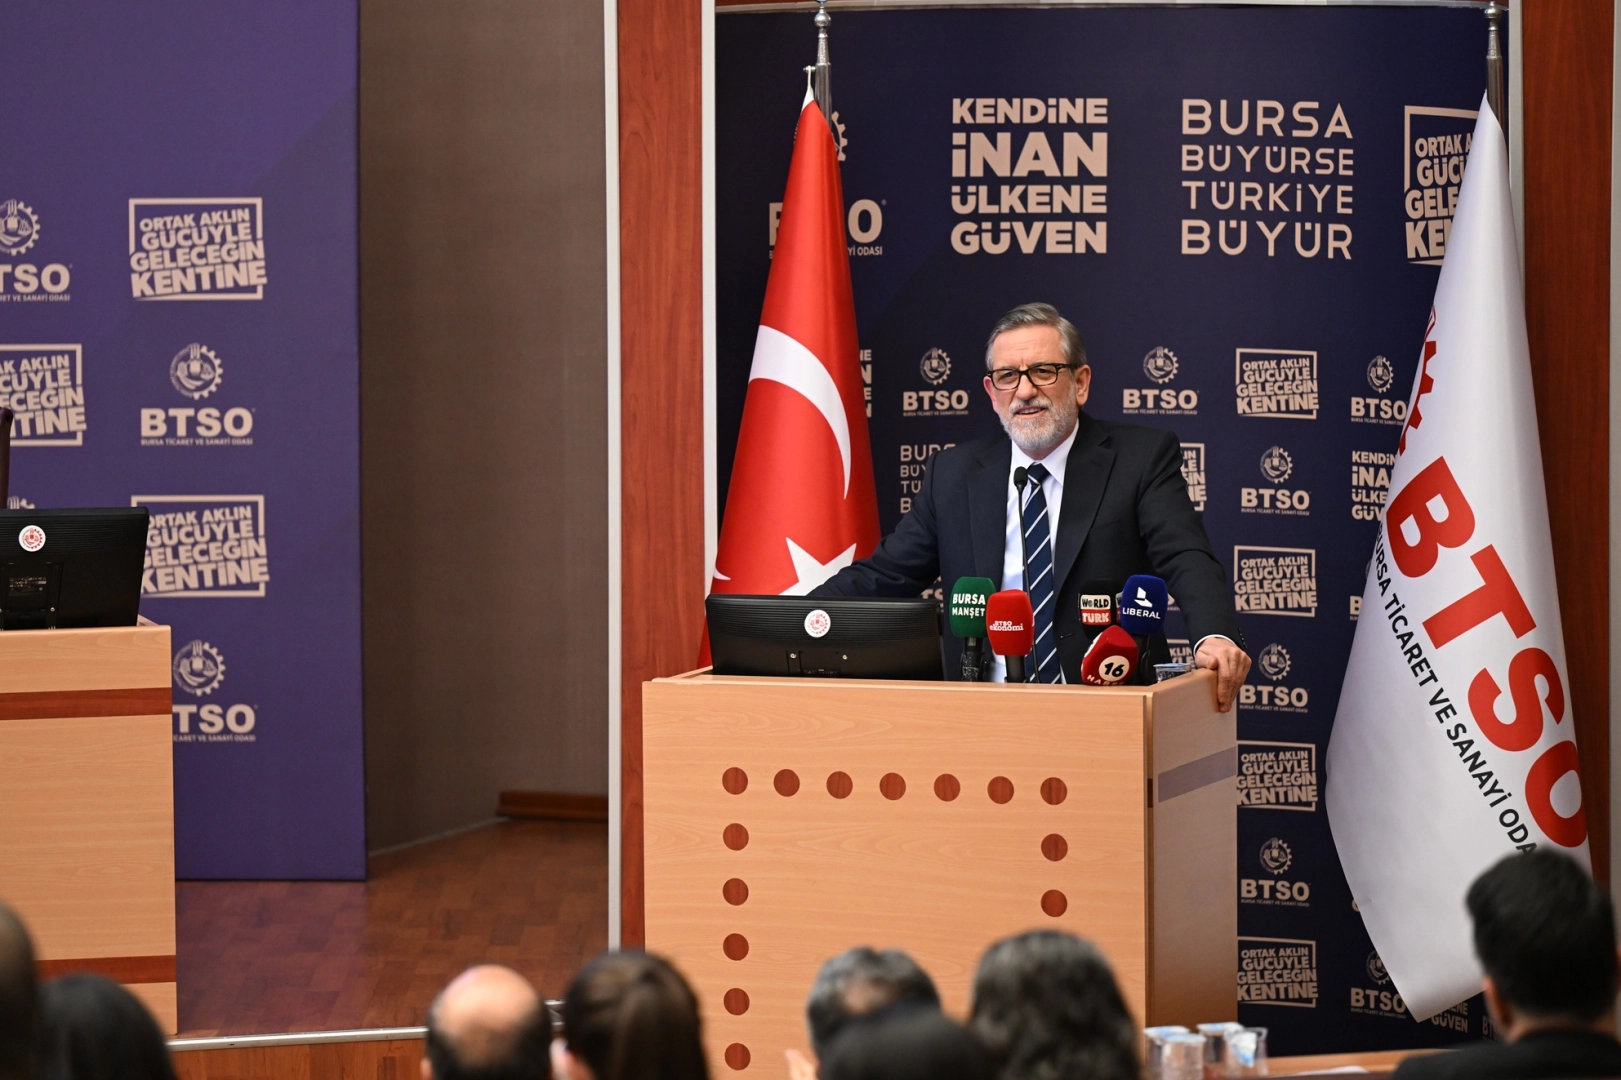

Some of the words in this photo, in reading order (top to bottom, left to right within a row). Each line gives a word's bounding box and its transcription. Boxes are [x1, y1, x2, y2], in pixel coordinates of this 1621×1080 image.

[953, 98, 1108, 124] KENDİNE
[1182, 99, 1353, 139] BURSA
[952, 132, 1108, 177] İNAN
[1415, 134, 1463, 157] ORTAK
[1182, 144, 1354, 176] BÜYÜRSE
[951, 185, 1107, 214] ÜLKENE
[1182, 181, 1353, 214] TÜRKİYE
[139, 213, 196, 232] ORTAK
[200, 208, 250, 226] AKLIN
[951, 221, 1107, 255] GÜVEN
[1182, 219, 1352, 260] BÜYÜR
[0, 263, 70, 293] SO
[20, 354, 69, 373] AKLIN
[1243, 360, 1277, 371] ORTAK
[1280, 358, 1309, 368] AKLIN
[903, 390, 969, 411] BTSO
[1123, 389, 1198, 410] BTSO
[1351, 396, 1407, 420] BTSO
[10, 406, 87, 438] TİNE
[141, 407, 253, 437] BTSO
[1352, 451, 1396, 466] KENDİN
[1352, 466, 1390, 489] İNA
[1241, 487, 1310, 511] BTSO
[1352, 489, 1387, 504] ÜLKE
[202, 505, 252, 525] AKLIN
[1351, 505, 1385, 522] GÜV
[1241, 557, 1275, 568] ORTAK
[1278, 556, 1308, 566] AKLIN
[953, 593, 986, 605] BURSA
[952, 607, 986, 618] MANŞET
[1122, 607, 1161, 620] LIBERAL
[989, 622, 1024, 631] ekonomi
[1169, 646, 1192, 657] KLIN
[1386, 456, 1588, 848] BTSO
[1104, 662, 1125, 677] 16
[1240, 684, 1308, 708] BTSO
[172, 703, 256, 733] TSO
[1385, 593, 1438, 687] TİCARET
[1428, 687, 1457, 724] VE
[1446, 723, 1512, 808] SANAYİ
[1499, 808, 1538, 857] ODA
[1241, 752, 1275, 762] ORTAK
[1278, 750, 1308, 761] AKLIN
[1241, 879, 1310, 901] BTSO
[1241, 949, 1276, 959] ORTAK
[1279, 947, 1309, 957] AKLIN
[1351, 987, 1406, 1013] BTSO
